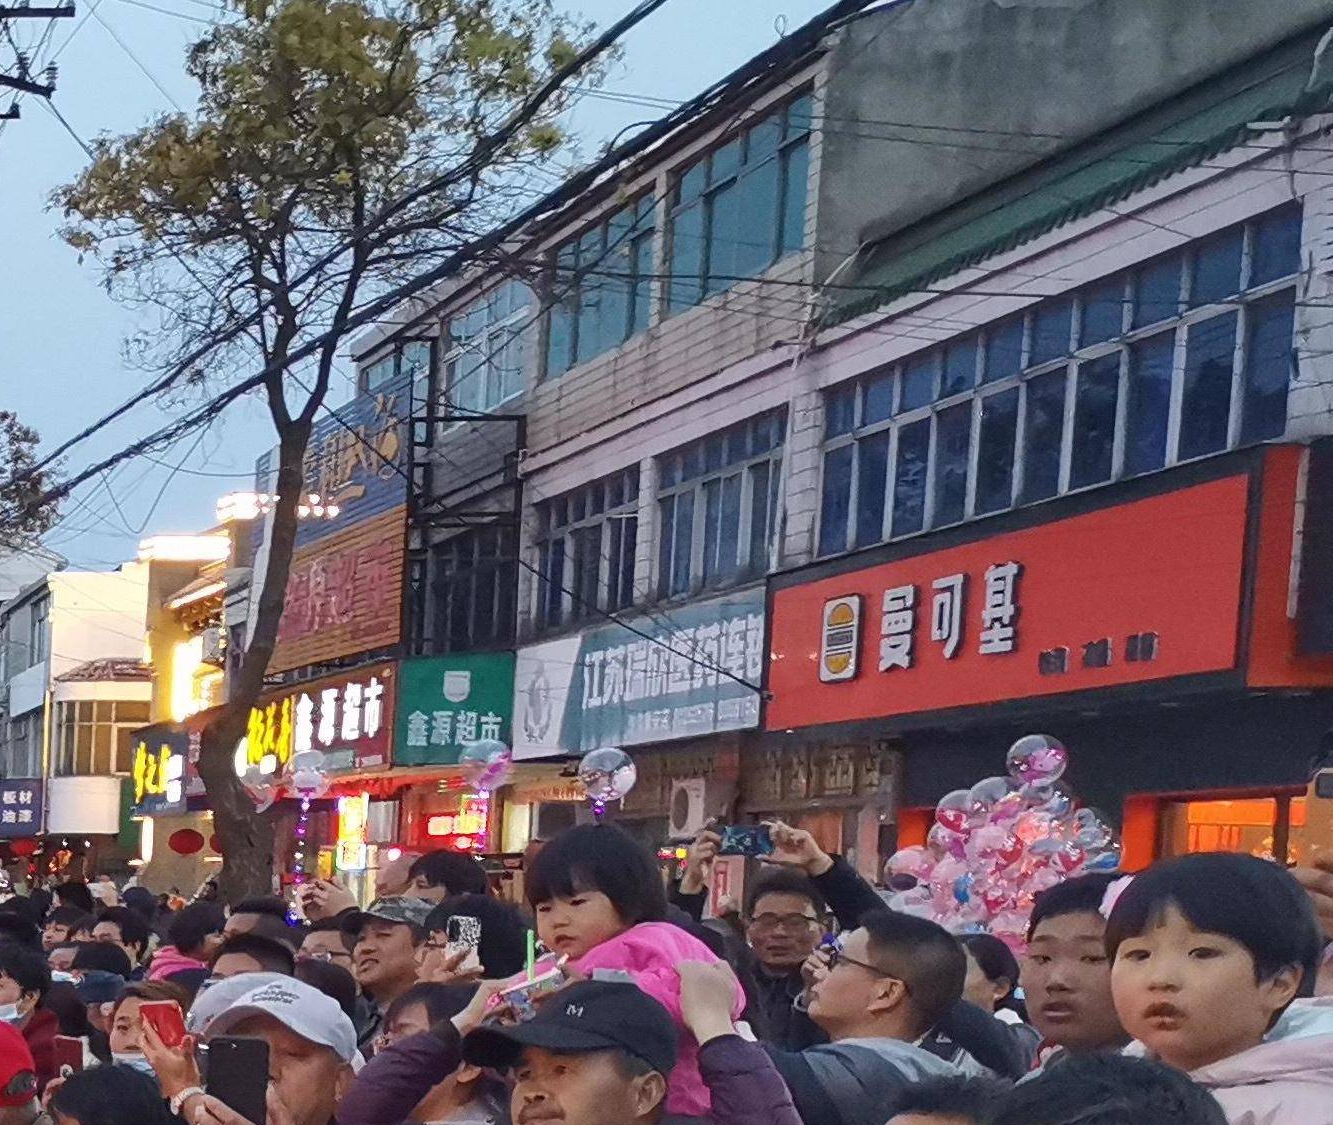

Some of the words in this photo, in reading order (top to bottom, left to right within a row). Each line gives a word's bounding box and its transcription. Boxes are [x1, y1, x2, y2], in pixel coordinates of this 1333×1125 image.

[878, 561, 1021, 673] 曼可基
[294, 676, 384, 751] 鑫源超市
[406, 709, 503, 747] 鑫源超市
[3, 790, 32, 804] 板材
